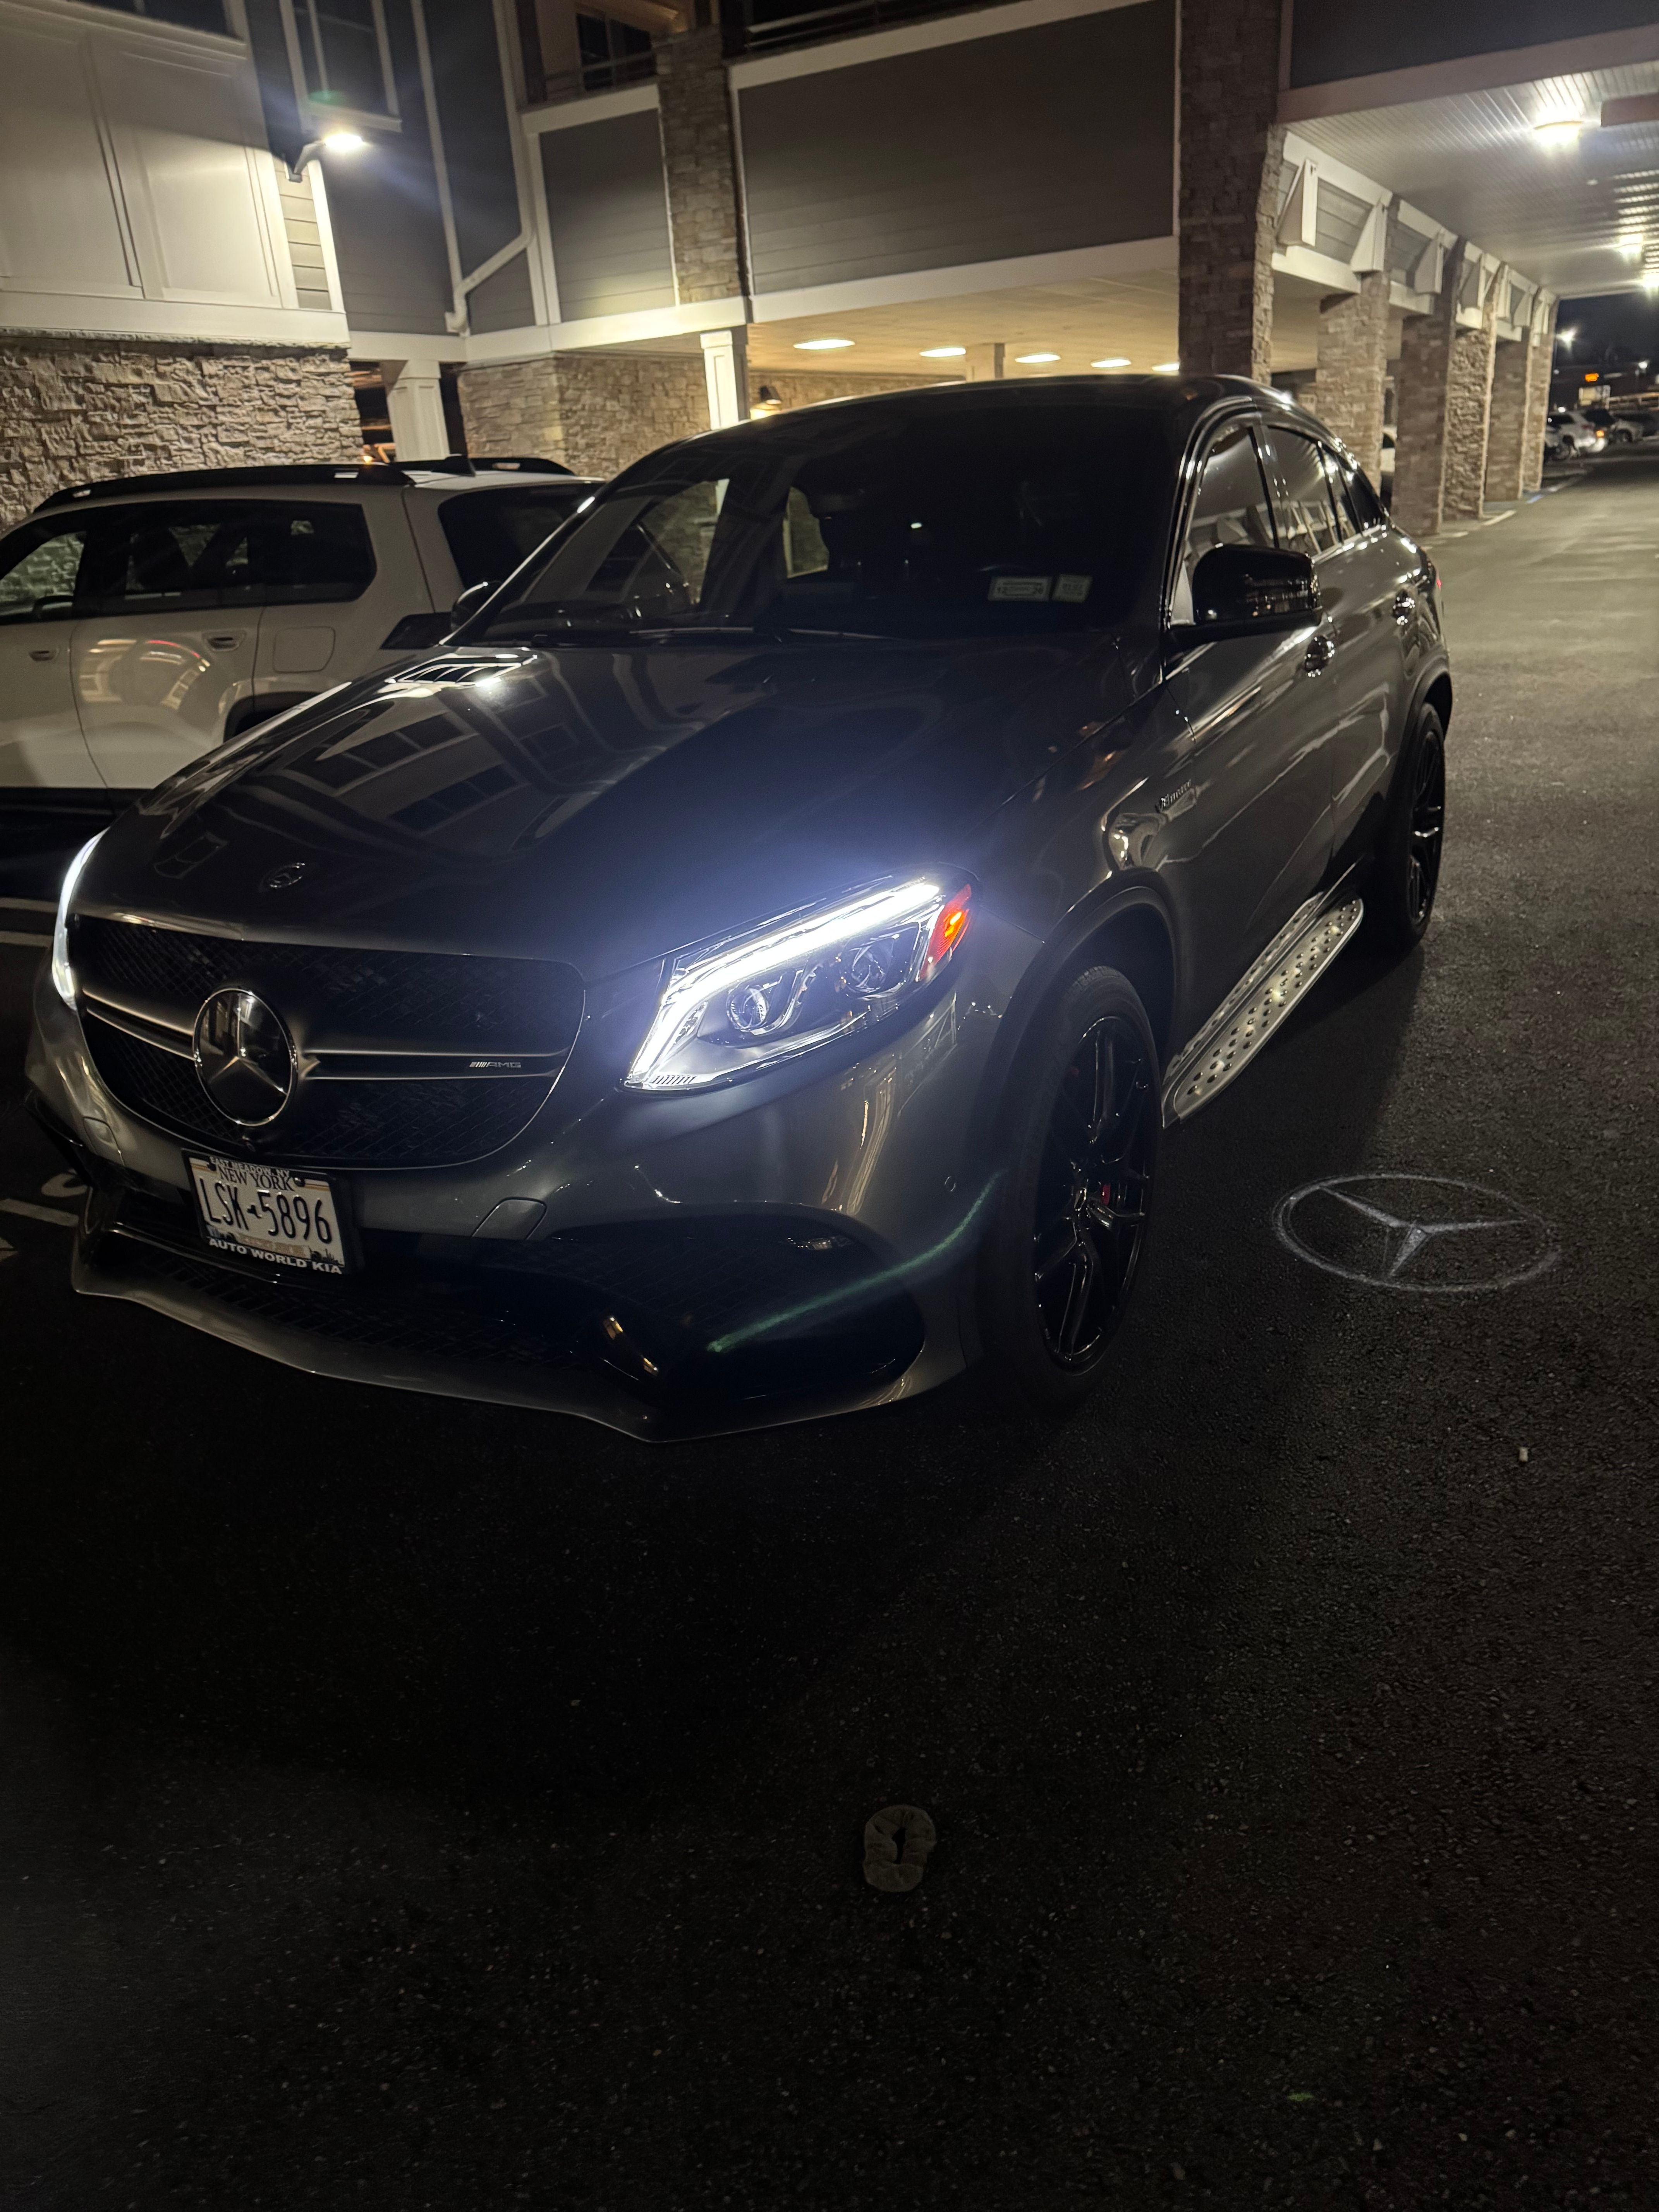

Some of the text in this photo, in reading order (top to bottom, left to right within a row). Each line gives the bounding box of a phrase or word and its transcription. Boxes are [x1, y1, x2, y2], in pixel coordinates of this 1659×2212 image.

[210, 1156, 229, 1168] EAST
[276, 1169, 290, 1177] NY
[218, 1166, 295, 1192] NEW YORK
[209, 1238, 342, 1275] AUTO WORLD KIA
